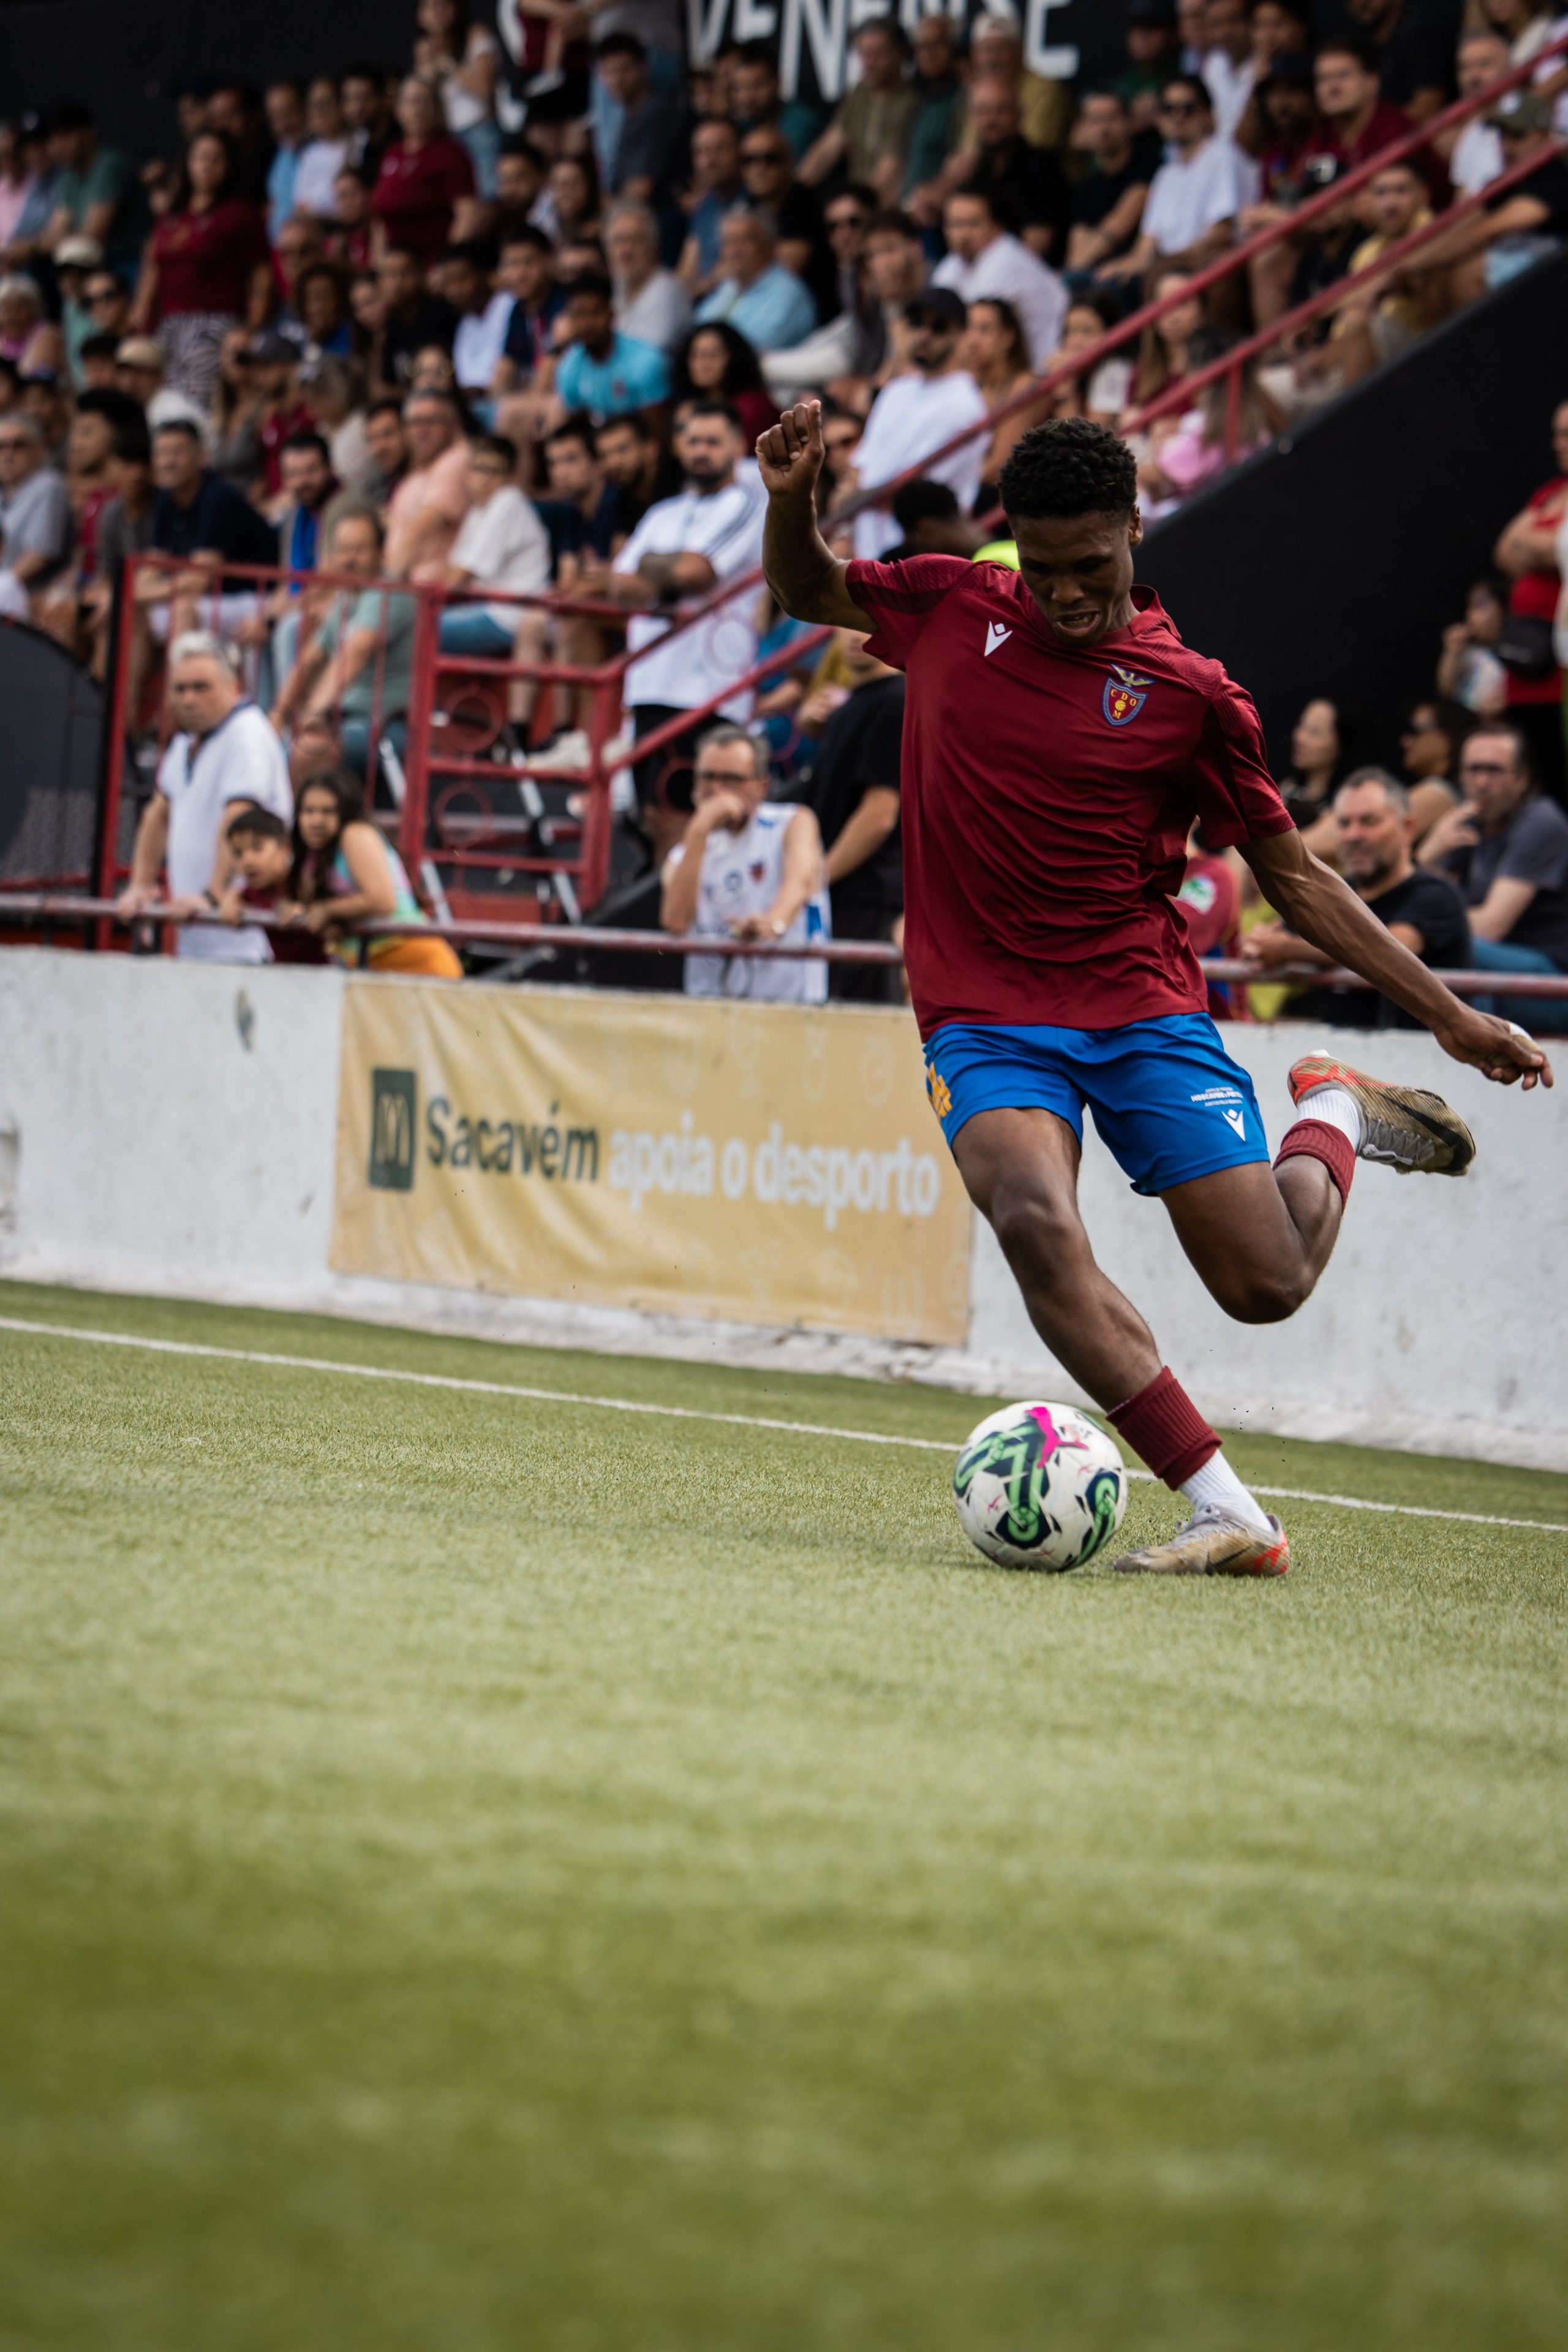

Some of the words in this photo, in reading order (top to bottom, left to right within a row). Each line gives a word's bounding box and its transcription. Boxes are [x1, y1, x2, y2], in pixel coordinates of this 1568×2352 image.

[427, 1095, 599, 1183] Sacavém
[609, 1109, 714, 1213] apoia
[721, 1137, 748, 1200] o
[753, 1121, 941, 1232] desporto
